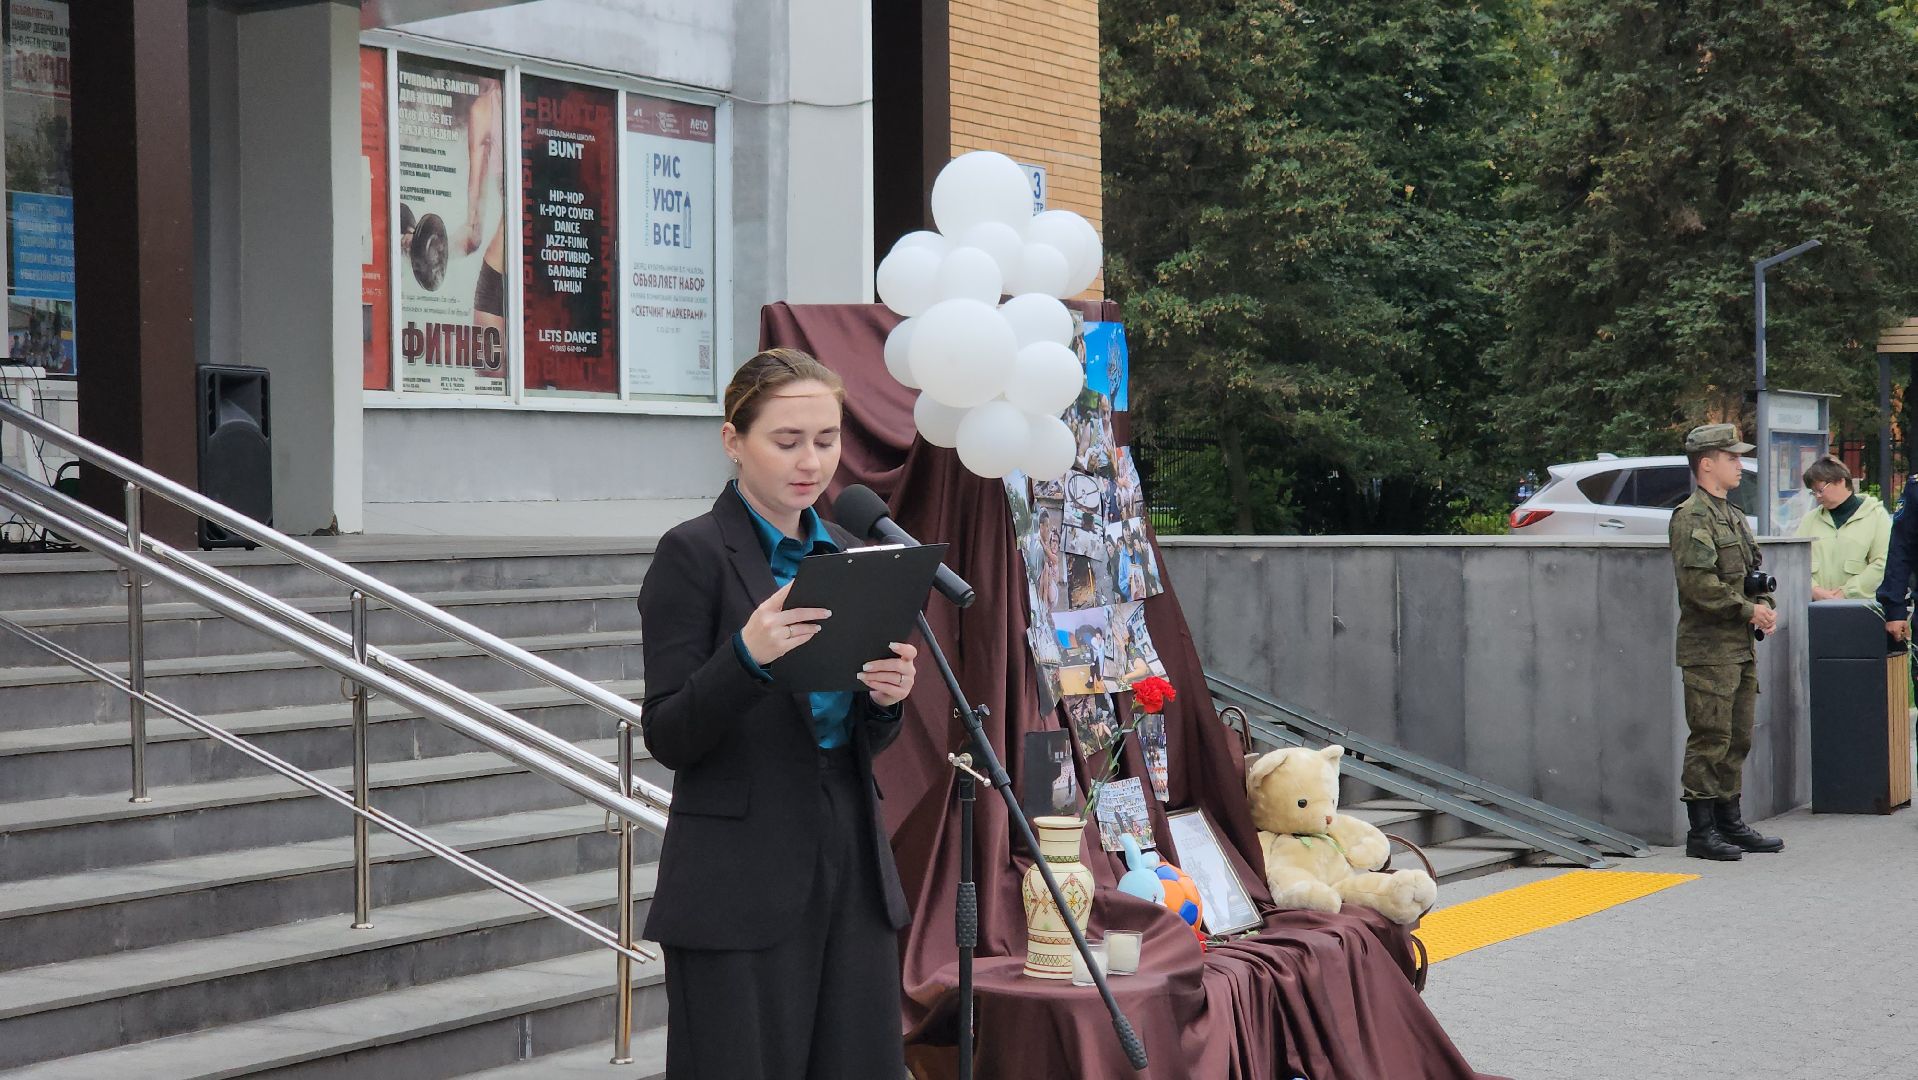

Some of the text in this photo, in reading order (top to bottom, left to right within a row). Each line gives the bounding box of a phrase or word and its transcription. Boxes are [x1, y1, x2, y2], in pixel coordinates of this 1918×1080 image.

[400, 71, 480, 96] ГРУППОВЫЕ ЗАНЯТИЯ
[417, 91, 453, 108] ЖЕНЩИН
[441, 114, 453, 126] ЛЕТ
[537, 128, 596, 142] ТАНЦЕВАЛЬНАЯ ШКОЛА
[549, 139, 585, 160] BUNT
[653, 152, 681, 179] РИС
[1033, 171, 1041, 199] 3
[549, 189, 584, 205] HIP-HOP
[653, 187, 683, 213] УЮТ
[540, 204, 594, 220] K-POP COVER
[554, 220, 580, 234] DANCE
[653, 222, 681, 248] ВСЕ
[546, 234, 588, 249] JAZZ-FUNK
[541, 248, 594, 264] СПОРТИВНО-
[548, 265, 587, 279] БАЛЬНЫЕ
[553, 279, 582, 295] ТАНЦЫ
[632, 272, 706, 292] ОБЪЯВЛЯЕТ НАБОР
[539, 328, 598, 345] LETS DANCE
[402, 321, 502, 370] ФИТНЕС
